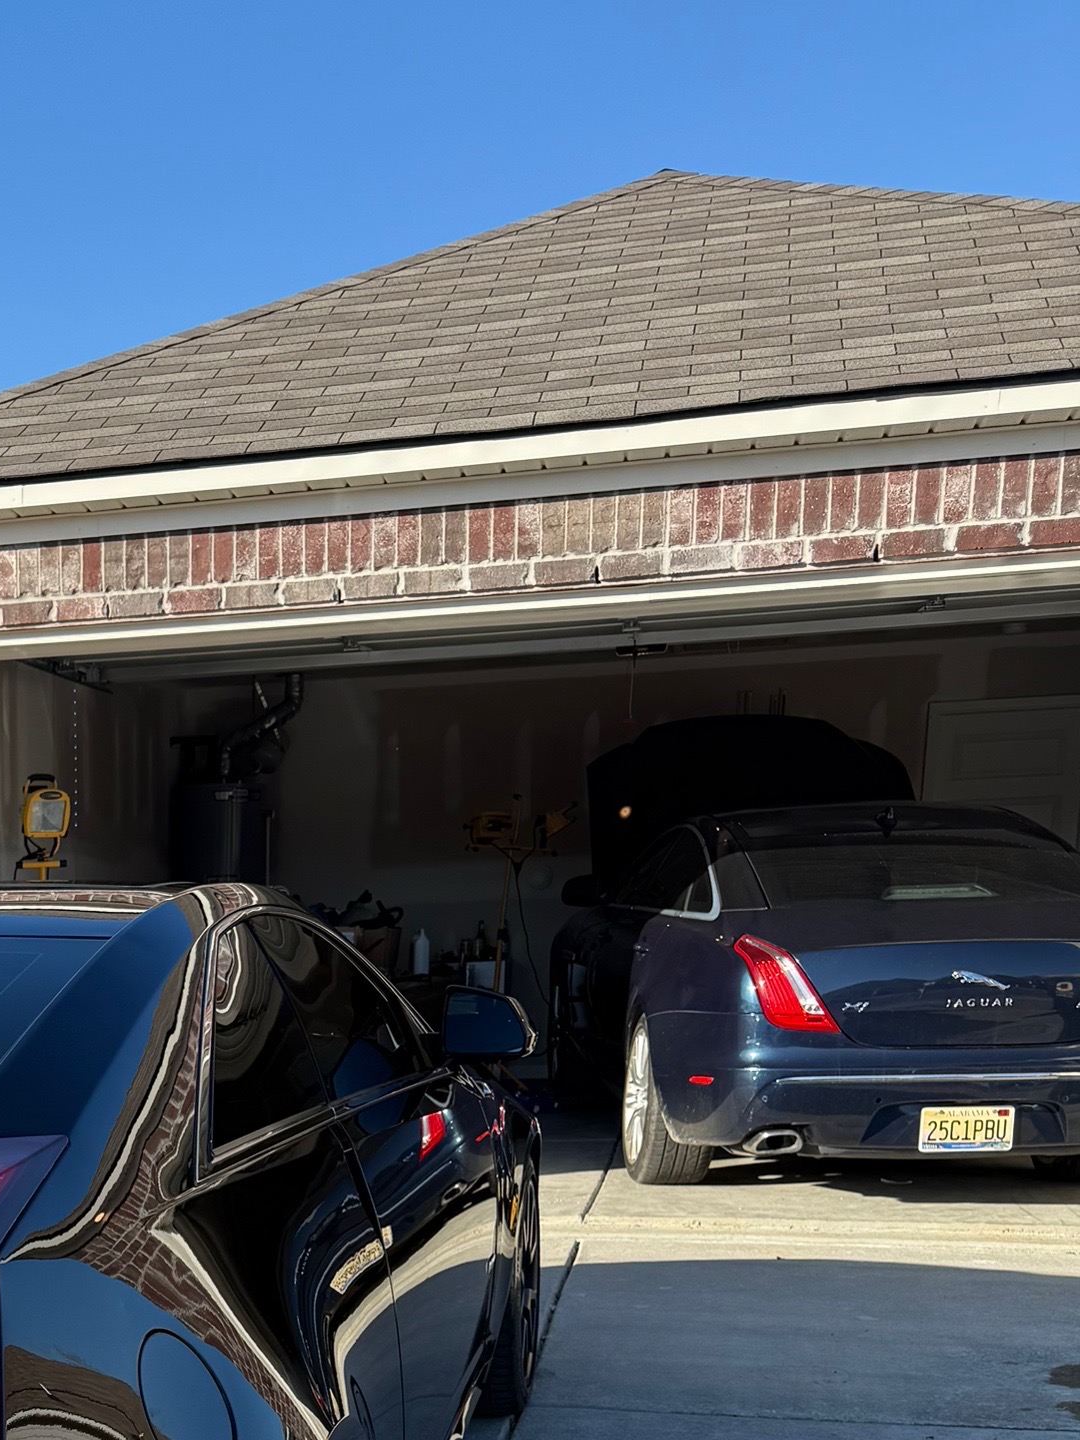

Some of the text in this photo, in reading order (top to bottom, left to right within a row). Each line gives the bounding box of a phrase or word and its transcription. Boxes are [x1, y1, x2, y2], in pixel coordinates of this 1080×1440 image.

[946, 997, 1013, 1008] JAGUAR
[947, 1108, 990, 1117] ALABAMA
[927, 1119, 1007, 1141] 25C1PBU
